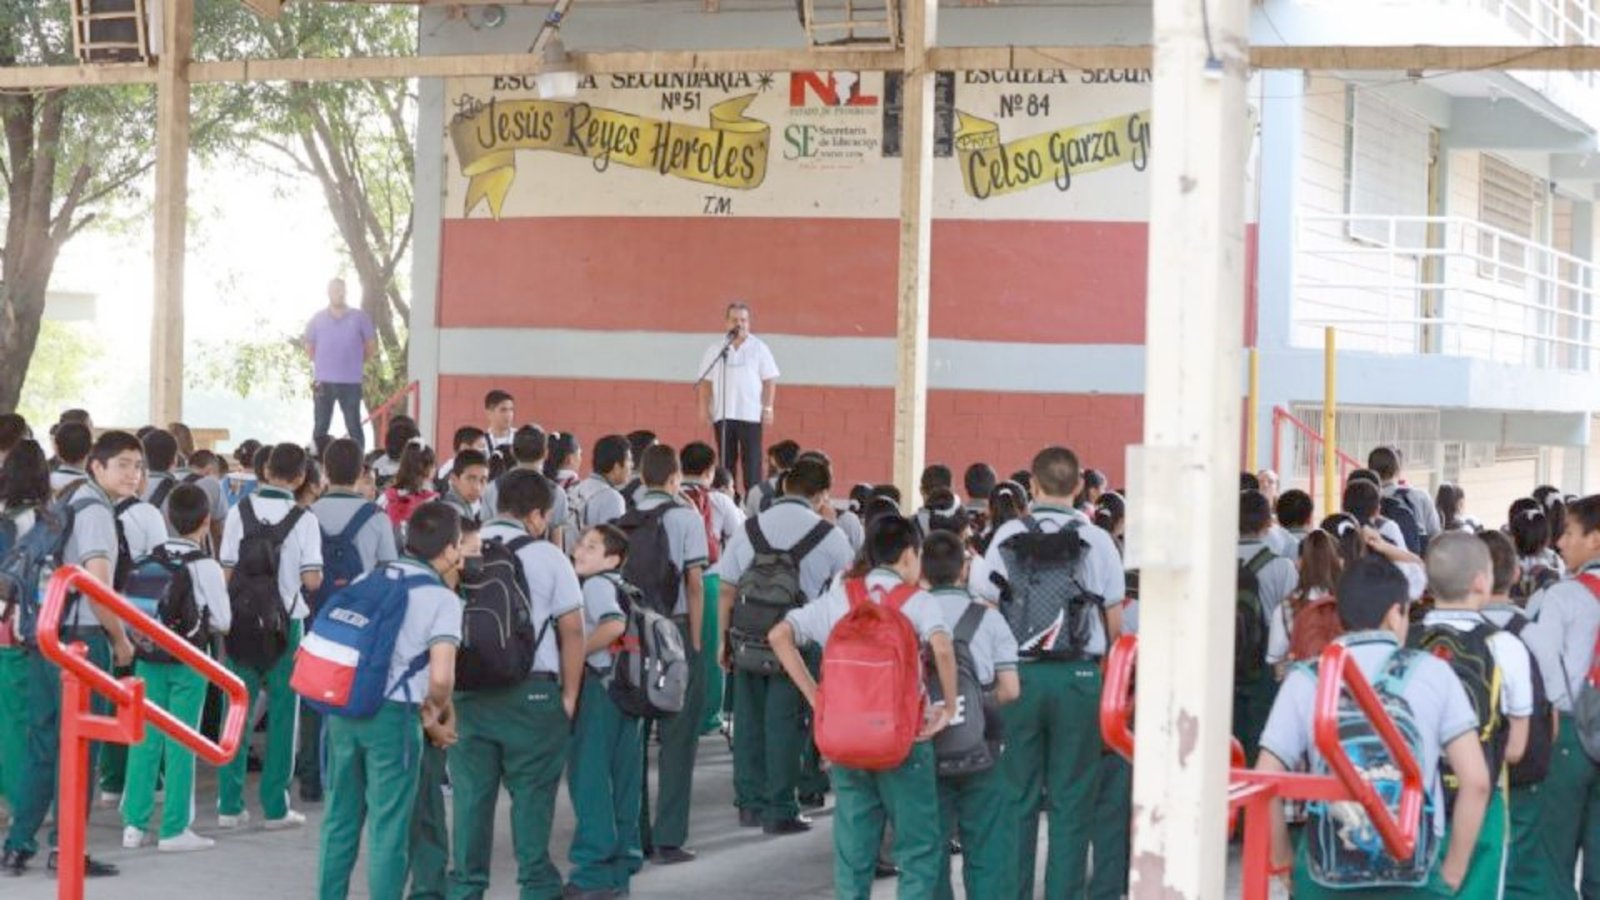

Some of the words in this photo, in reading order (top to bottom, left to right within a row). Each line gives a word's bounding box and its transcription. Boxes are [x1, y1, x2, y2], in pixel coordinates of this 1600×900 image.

[493, 74, 599, 91] ESCA
[1081, 68, 1152, 84] SECUN
[477, 96, 554, 149] Jesús
[564, 102, 640, 173] Reyes
[783, 123, 819, 161] SE
[968, 142, 1042, 200] Celso
